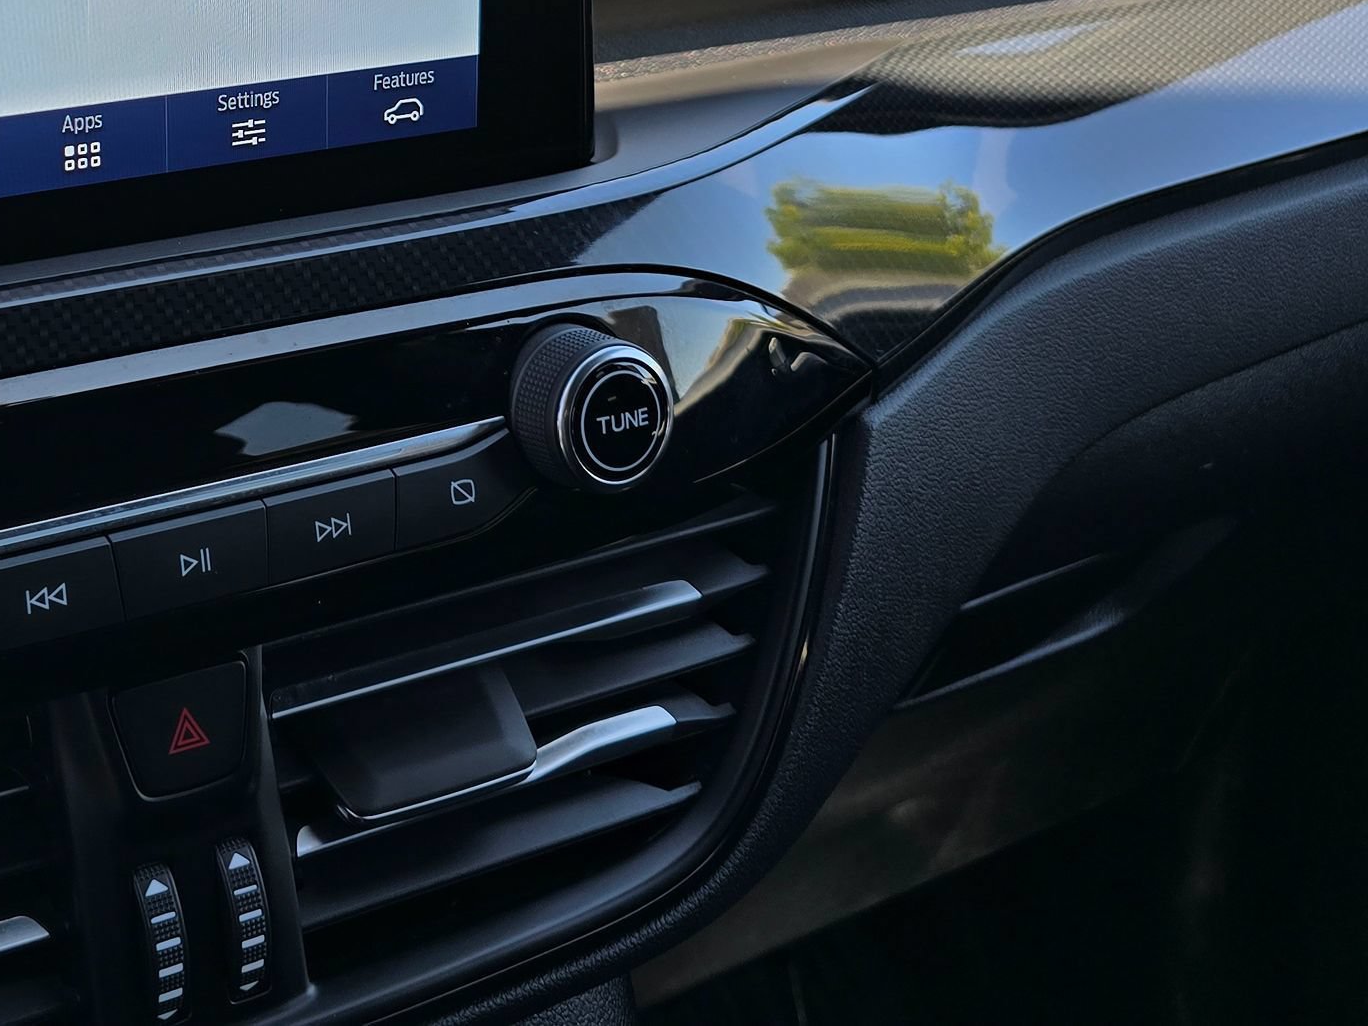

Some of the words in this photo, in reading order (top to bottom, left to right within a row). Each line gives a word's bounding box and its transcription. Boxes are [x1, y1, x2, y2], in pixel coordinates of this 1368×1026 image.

[373, 70, 435, 91] Features
[217, 89, 281, 112] Settings
[61, 112, 104, 134] Apps
[596, 406, 649, 435] TUNE
